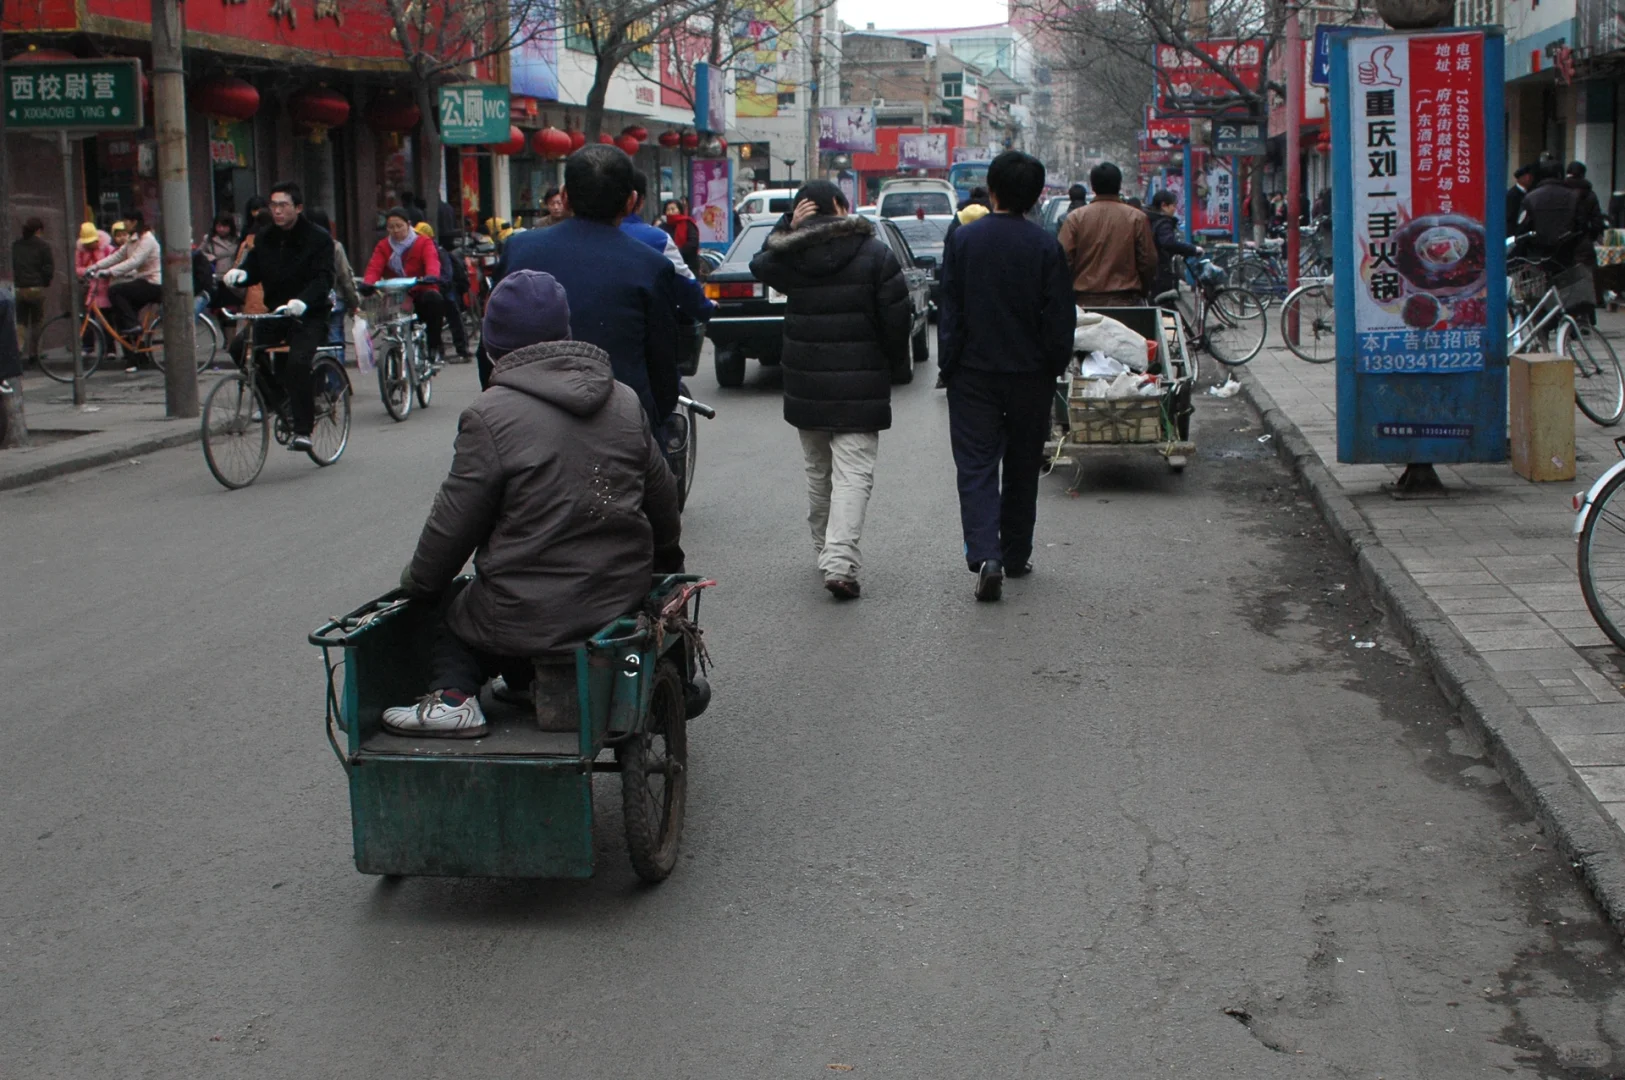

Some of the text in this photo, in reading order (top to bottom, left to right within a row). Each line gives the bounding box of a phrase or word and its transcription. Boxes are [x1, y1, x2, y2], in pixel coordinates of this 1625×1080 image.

[10, 73, 115, 100] 西校尉营
[24, 105, 105, 119] XIXIAOWEI YING
[441, 89, 506, 127] 公厕 WC
[1366, 89, 1400, 300] 重庆刘一手火锅
[1361, 330, 1482, 353] 本广告位招商
[1362, 352, 1484, 371] 13303412222
